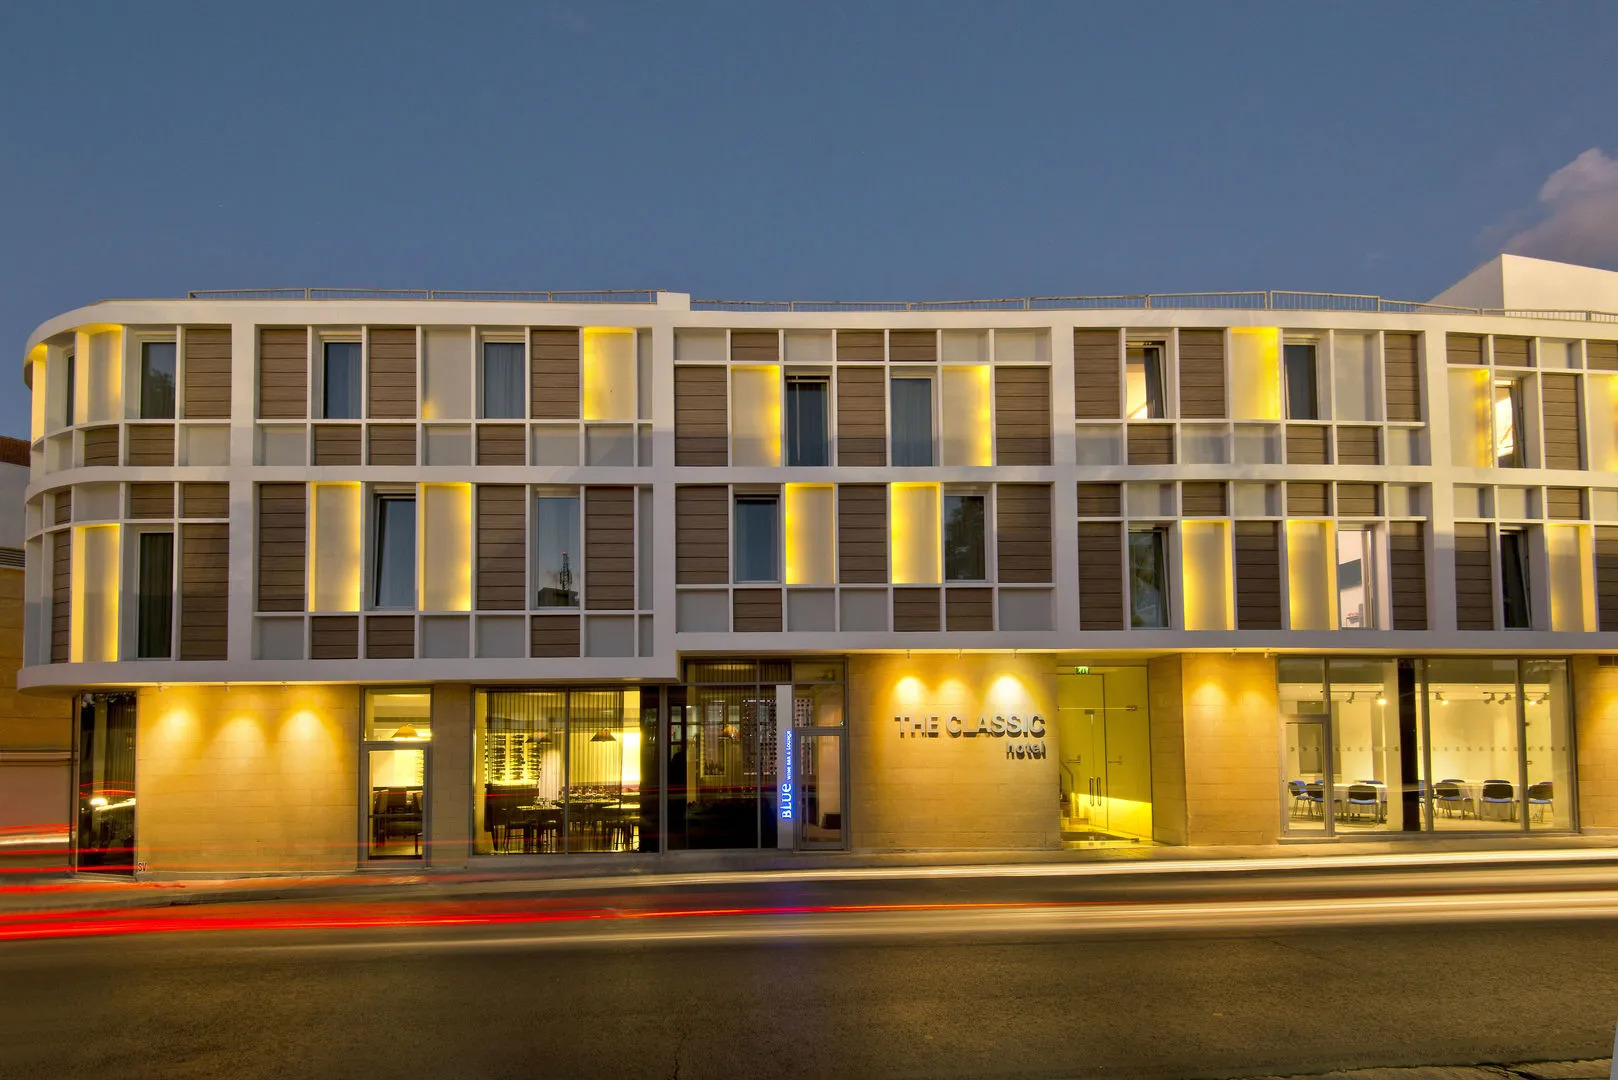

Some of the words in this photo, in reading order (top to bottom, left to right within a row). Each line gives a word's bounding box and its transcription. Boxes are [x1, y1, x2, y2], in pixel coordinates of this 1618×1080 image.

[894, 714, 939, 737] THE
[946, 713, 1046, 737] CLASSIC
[1006, 741, 1047, 758] hotel
